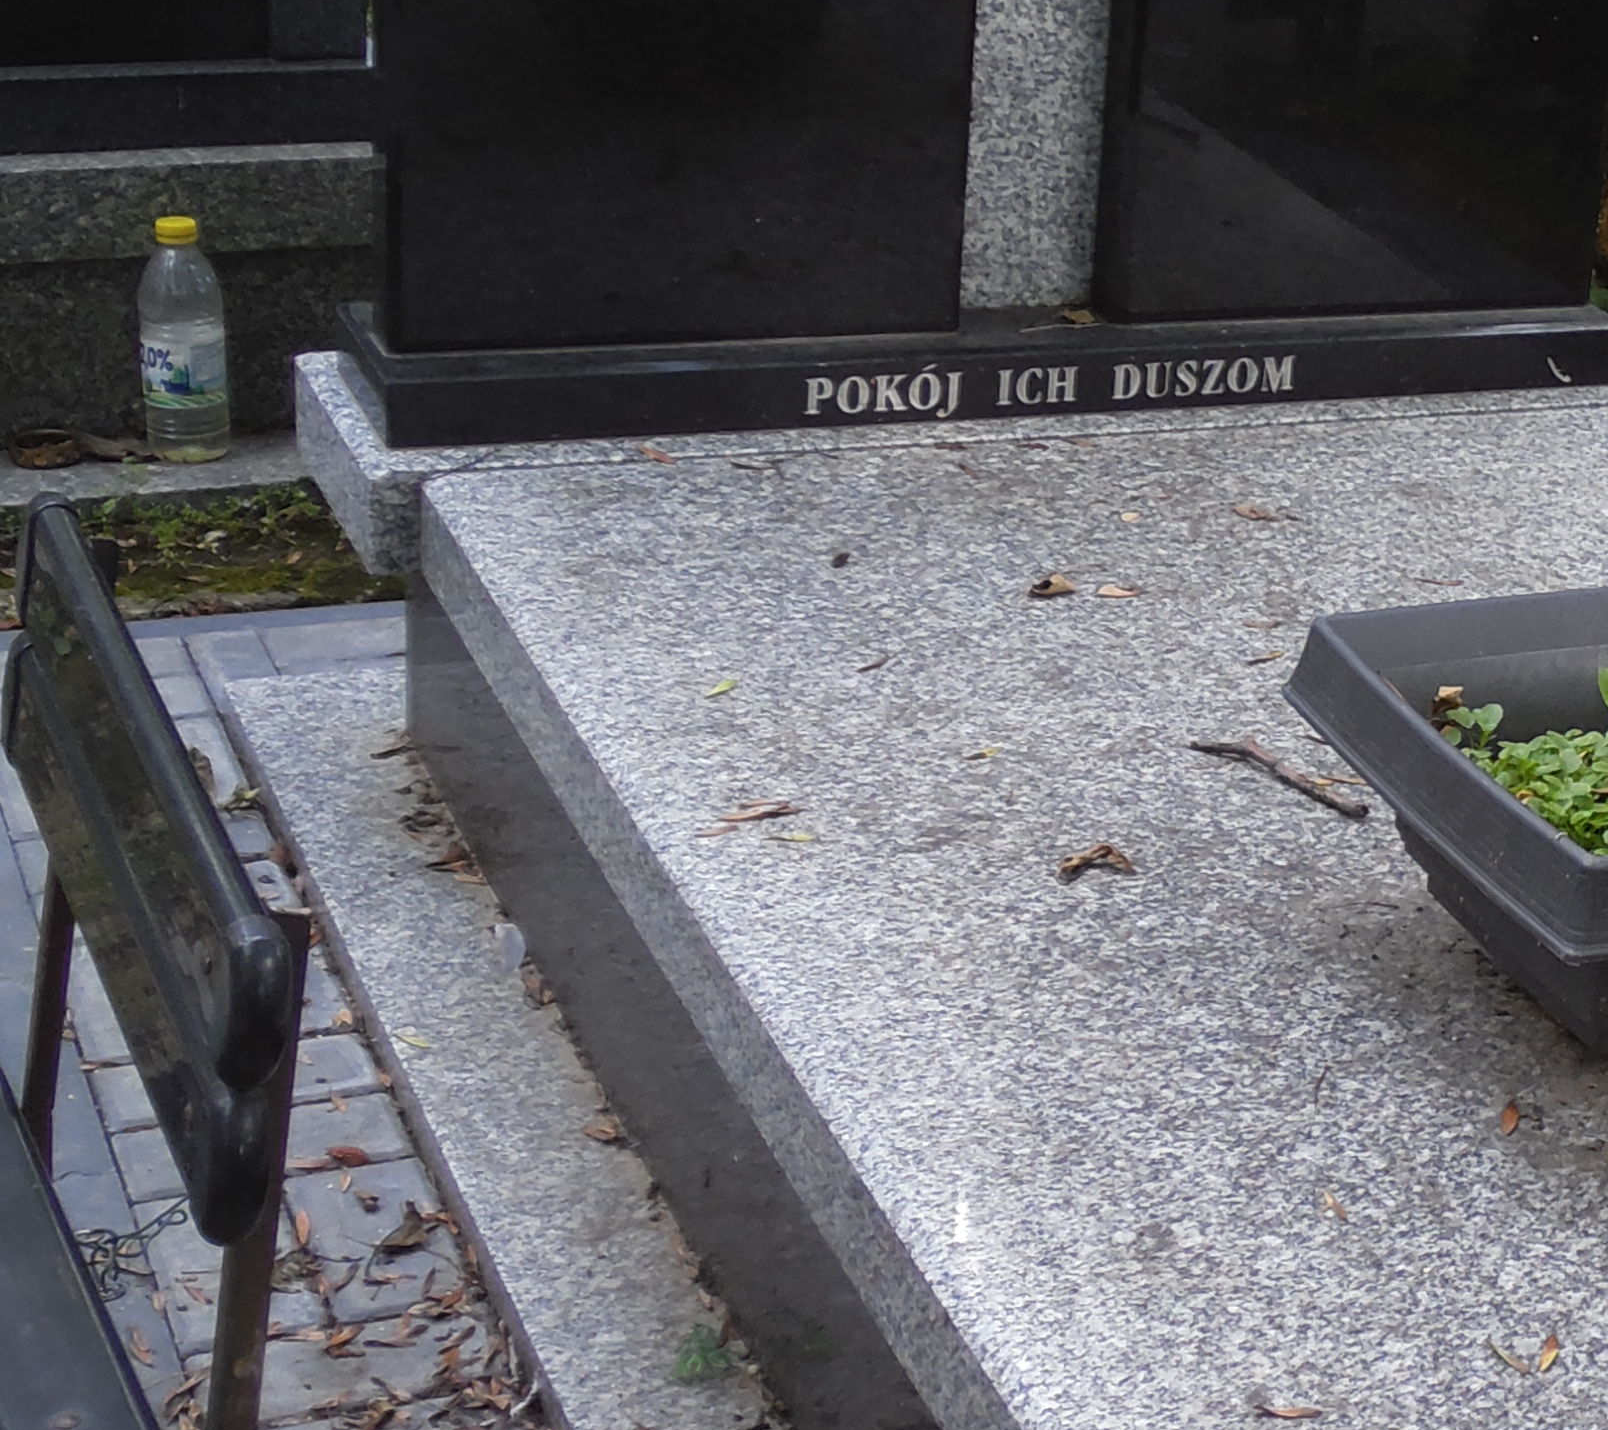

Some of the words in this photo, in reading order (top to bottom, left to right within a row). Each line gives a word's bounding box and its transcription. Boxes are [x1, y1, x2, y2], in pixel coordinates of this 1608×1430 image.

[804, 363, 962, 418] POKÓJ
[996, 367, 1078, 405] ICH
[1112, 354, 1297, 401] DUSZOM
